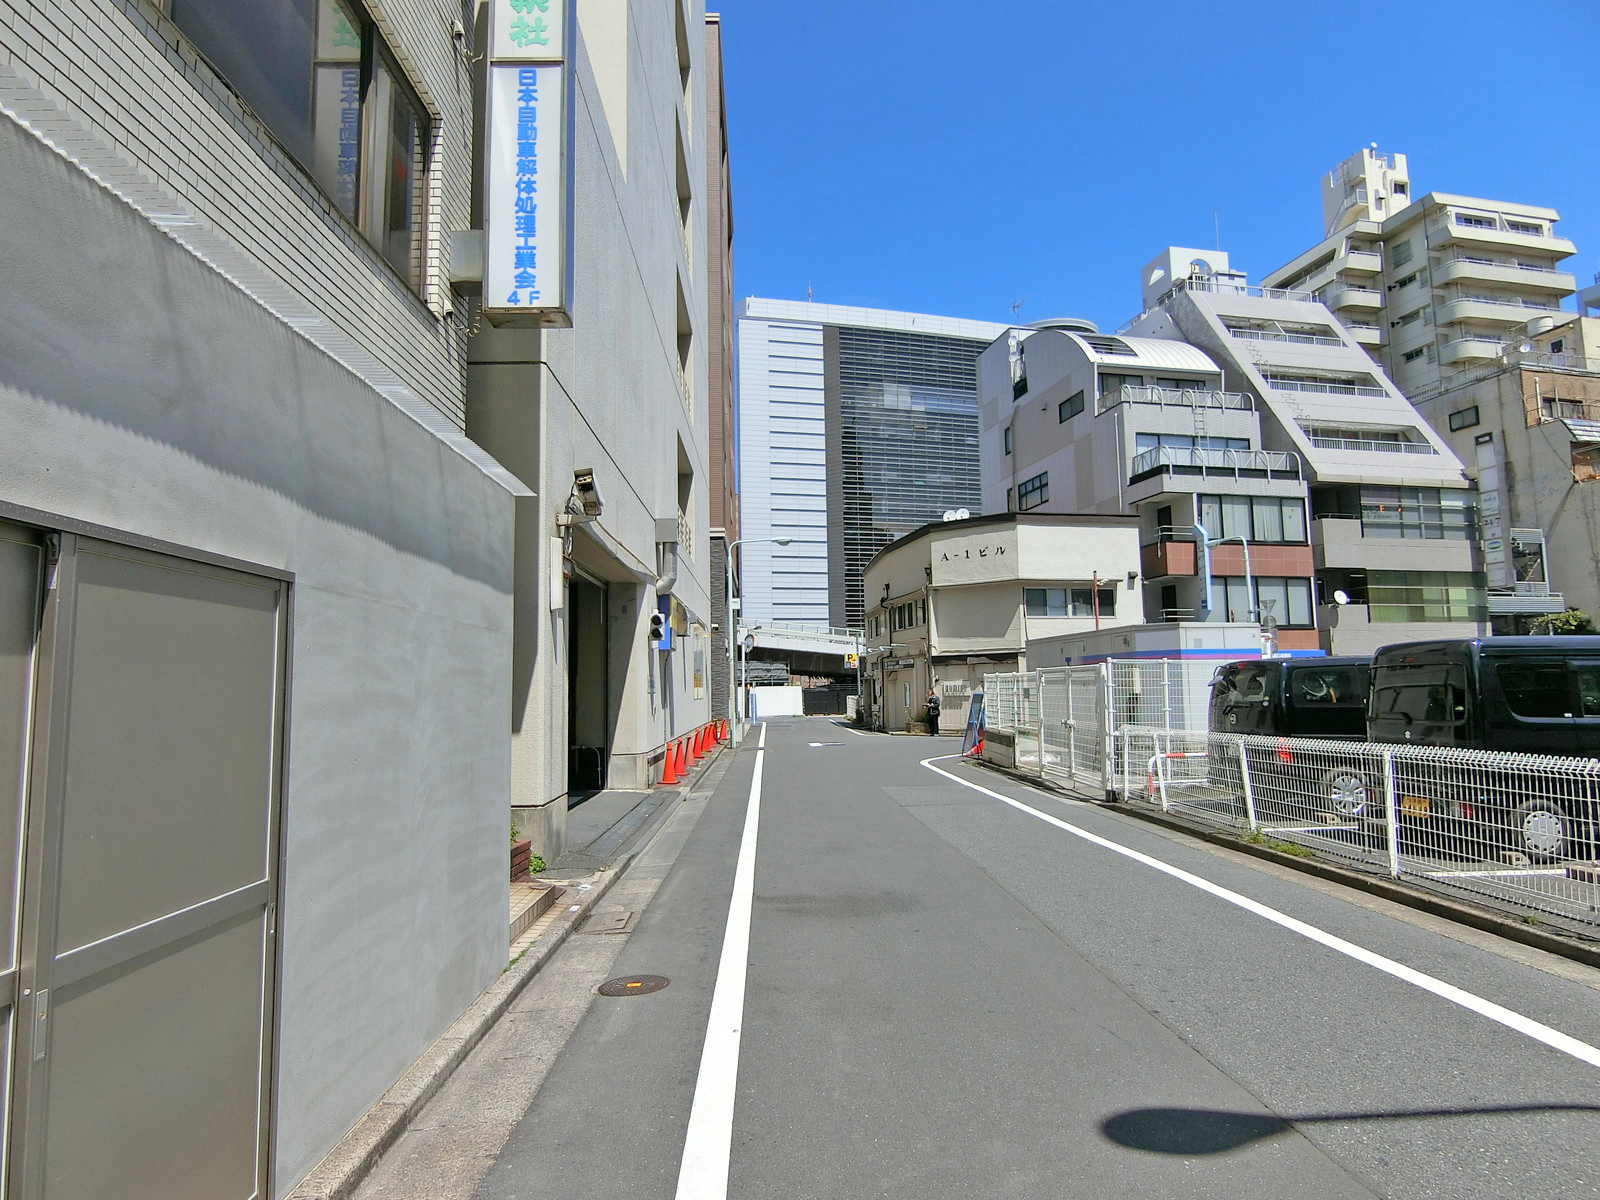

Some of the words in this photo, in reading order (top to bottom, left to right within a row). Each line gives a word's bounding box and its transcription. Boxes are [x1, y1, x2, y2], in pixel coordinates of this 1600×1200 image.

[514, 68, 538, 289] 日本自動車解体処理工業会
